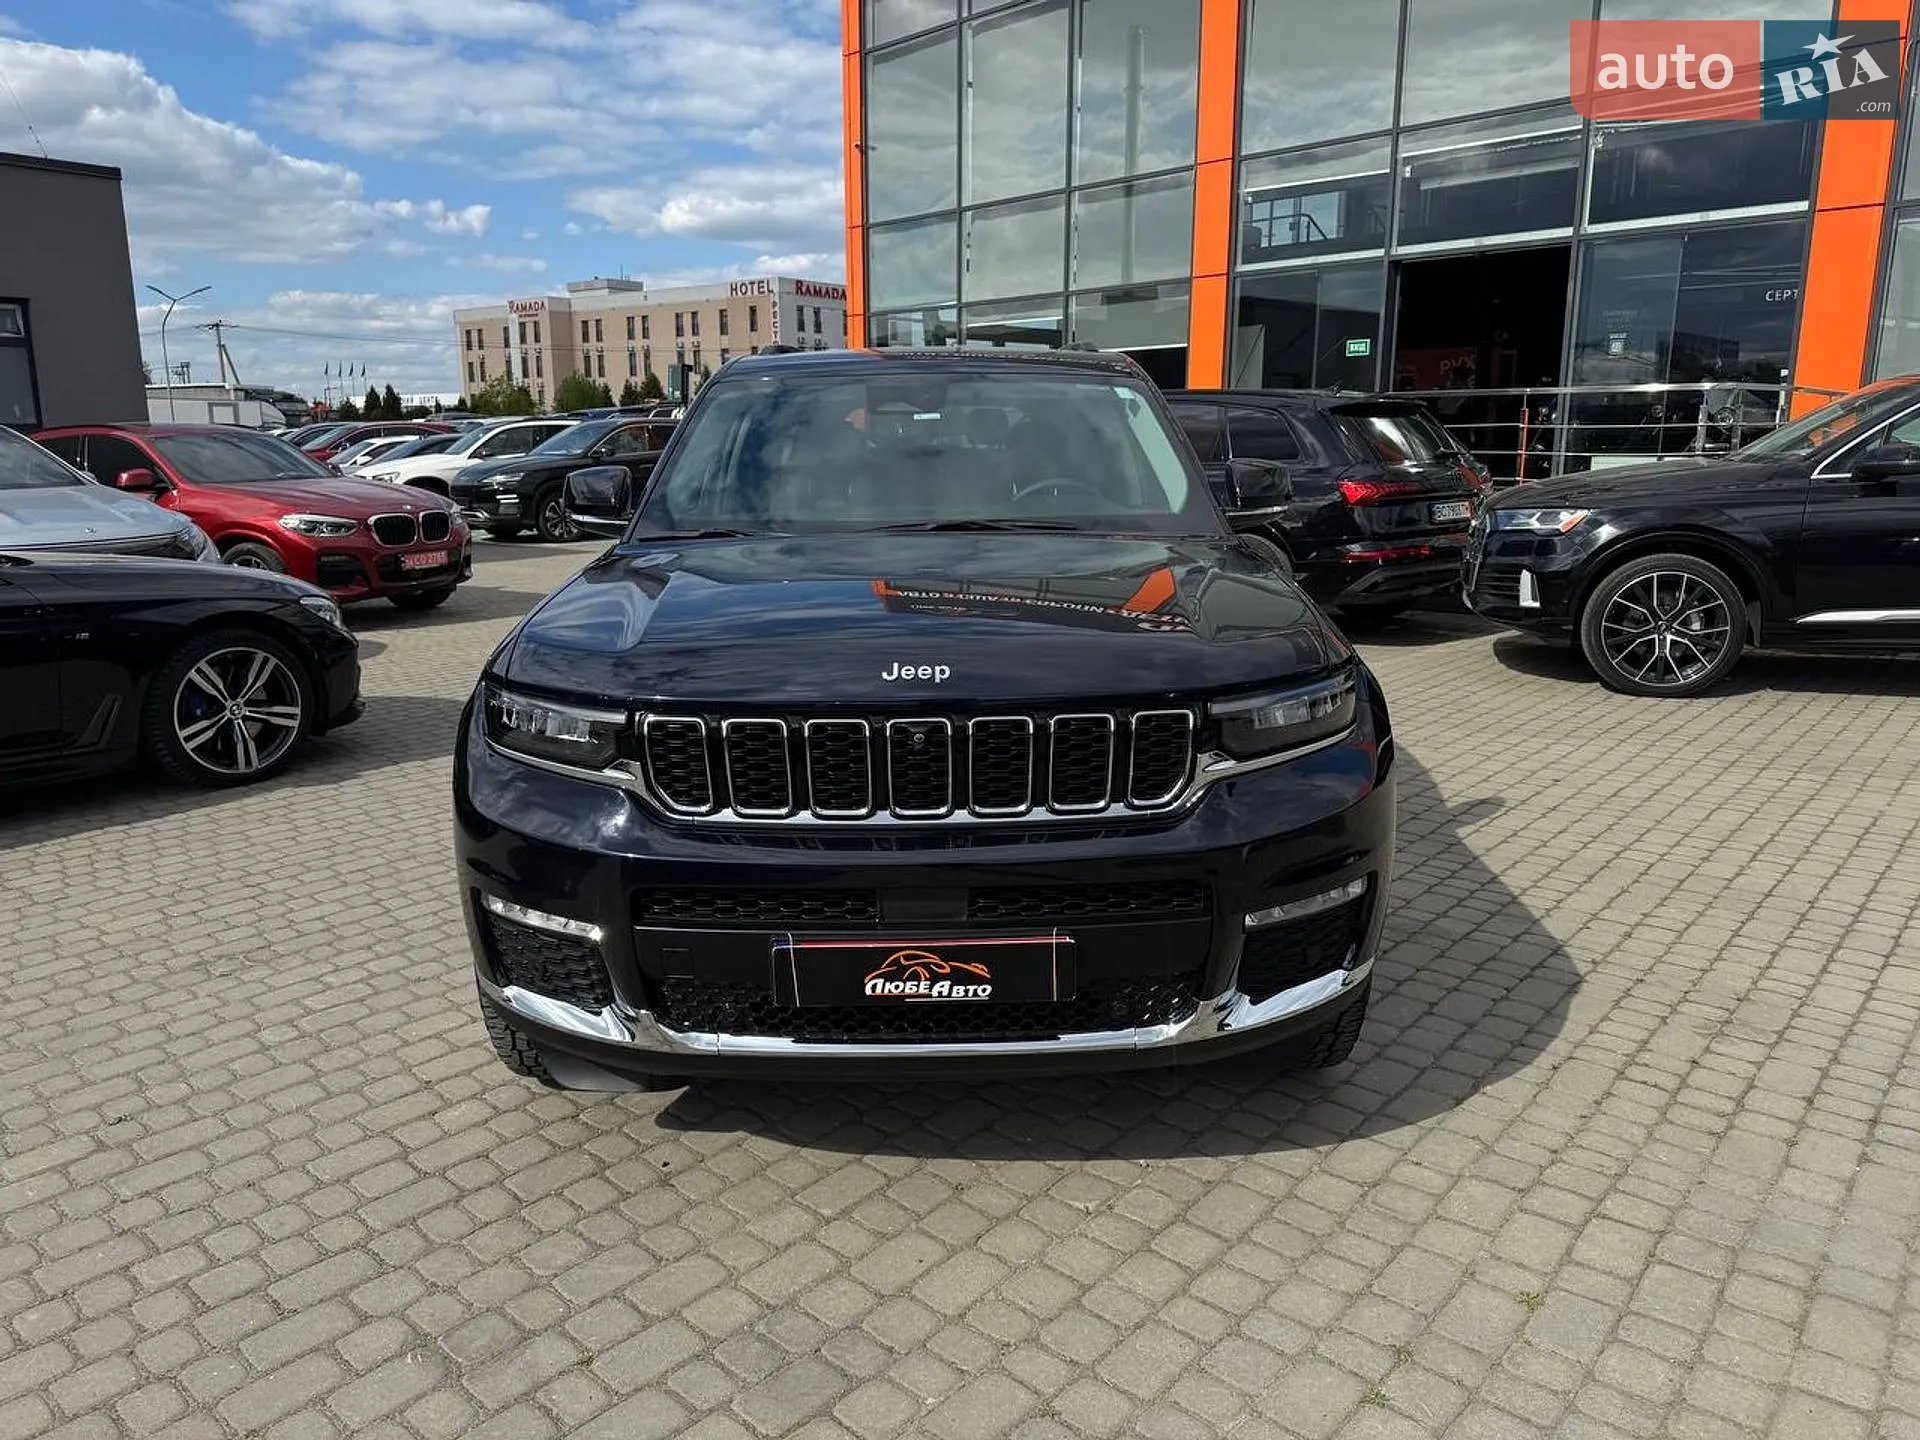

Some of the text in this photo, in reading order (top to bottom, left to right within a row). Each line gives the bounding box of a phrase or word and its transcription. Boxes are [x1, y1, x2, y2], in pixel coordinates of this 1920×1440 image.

[730, 280, 774, 297] HOTEL
[795, 279, 847, 301] RAMADA
[508, 300, 546, 313] RAMADA
[881, 662, 952, 683] Jeep
